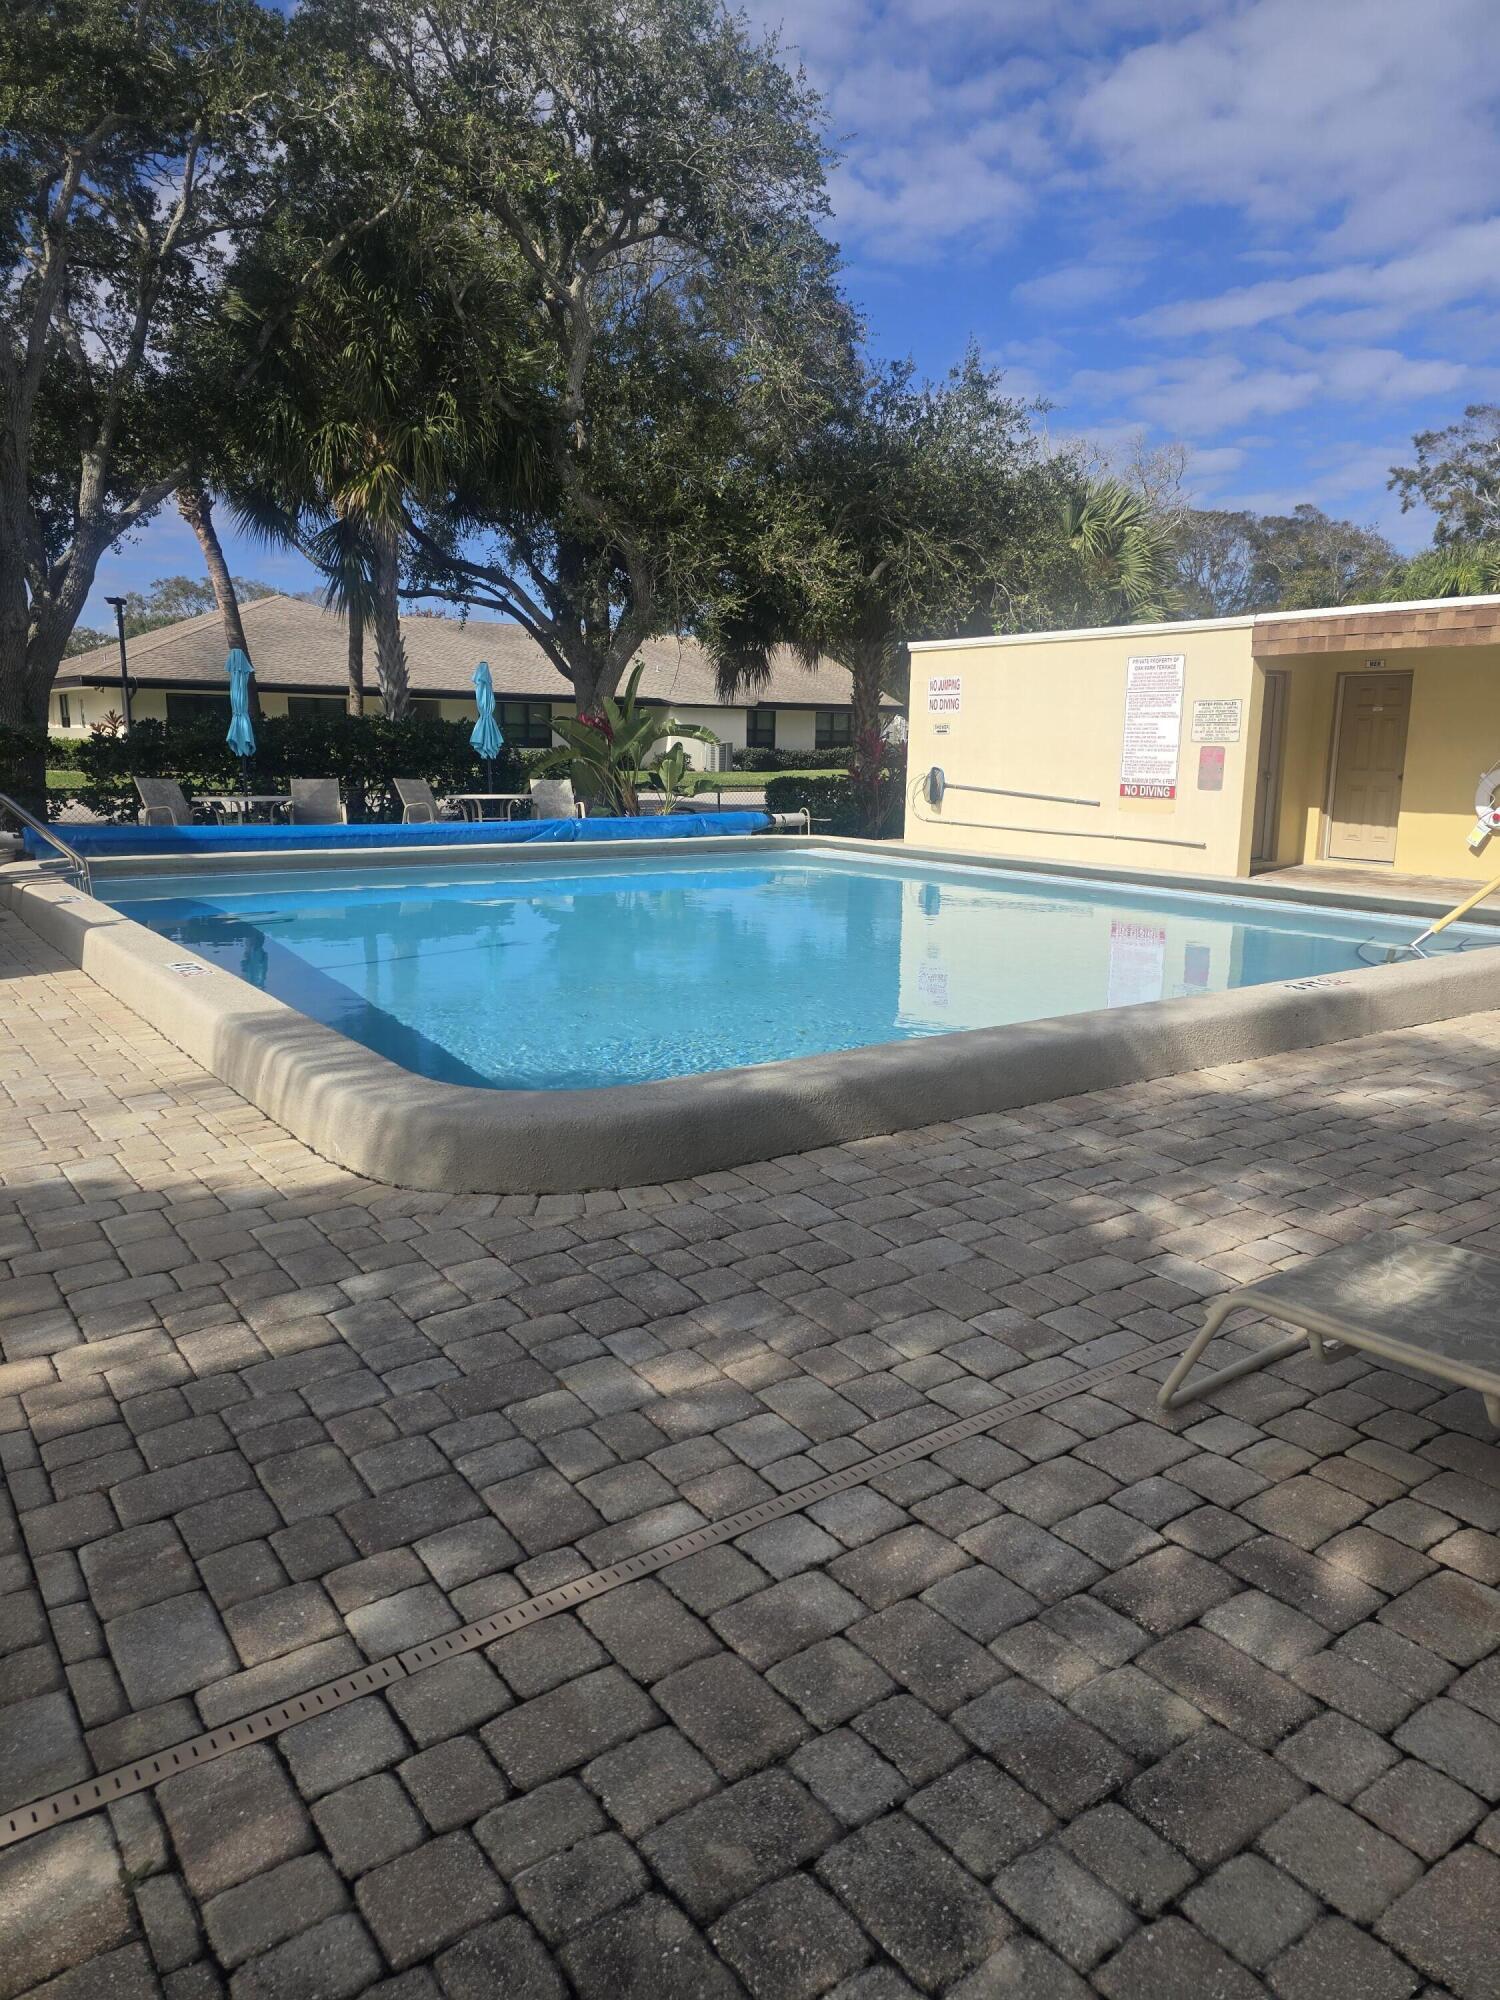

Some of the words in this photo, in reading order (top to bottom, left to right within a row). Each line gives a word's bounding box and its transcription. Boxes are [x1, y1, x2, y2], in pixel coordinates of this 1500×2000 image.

[929, 680, 937, 691] NO
[938, 678, 960, 691] JUMPING
[929, 699, 938, 711] NO
[939, 697, 960, 710] DIVING
[1124, 785, 1138, 796] NO
[1139, 786, 1170, 797] DIVING
